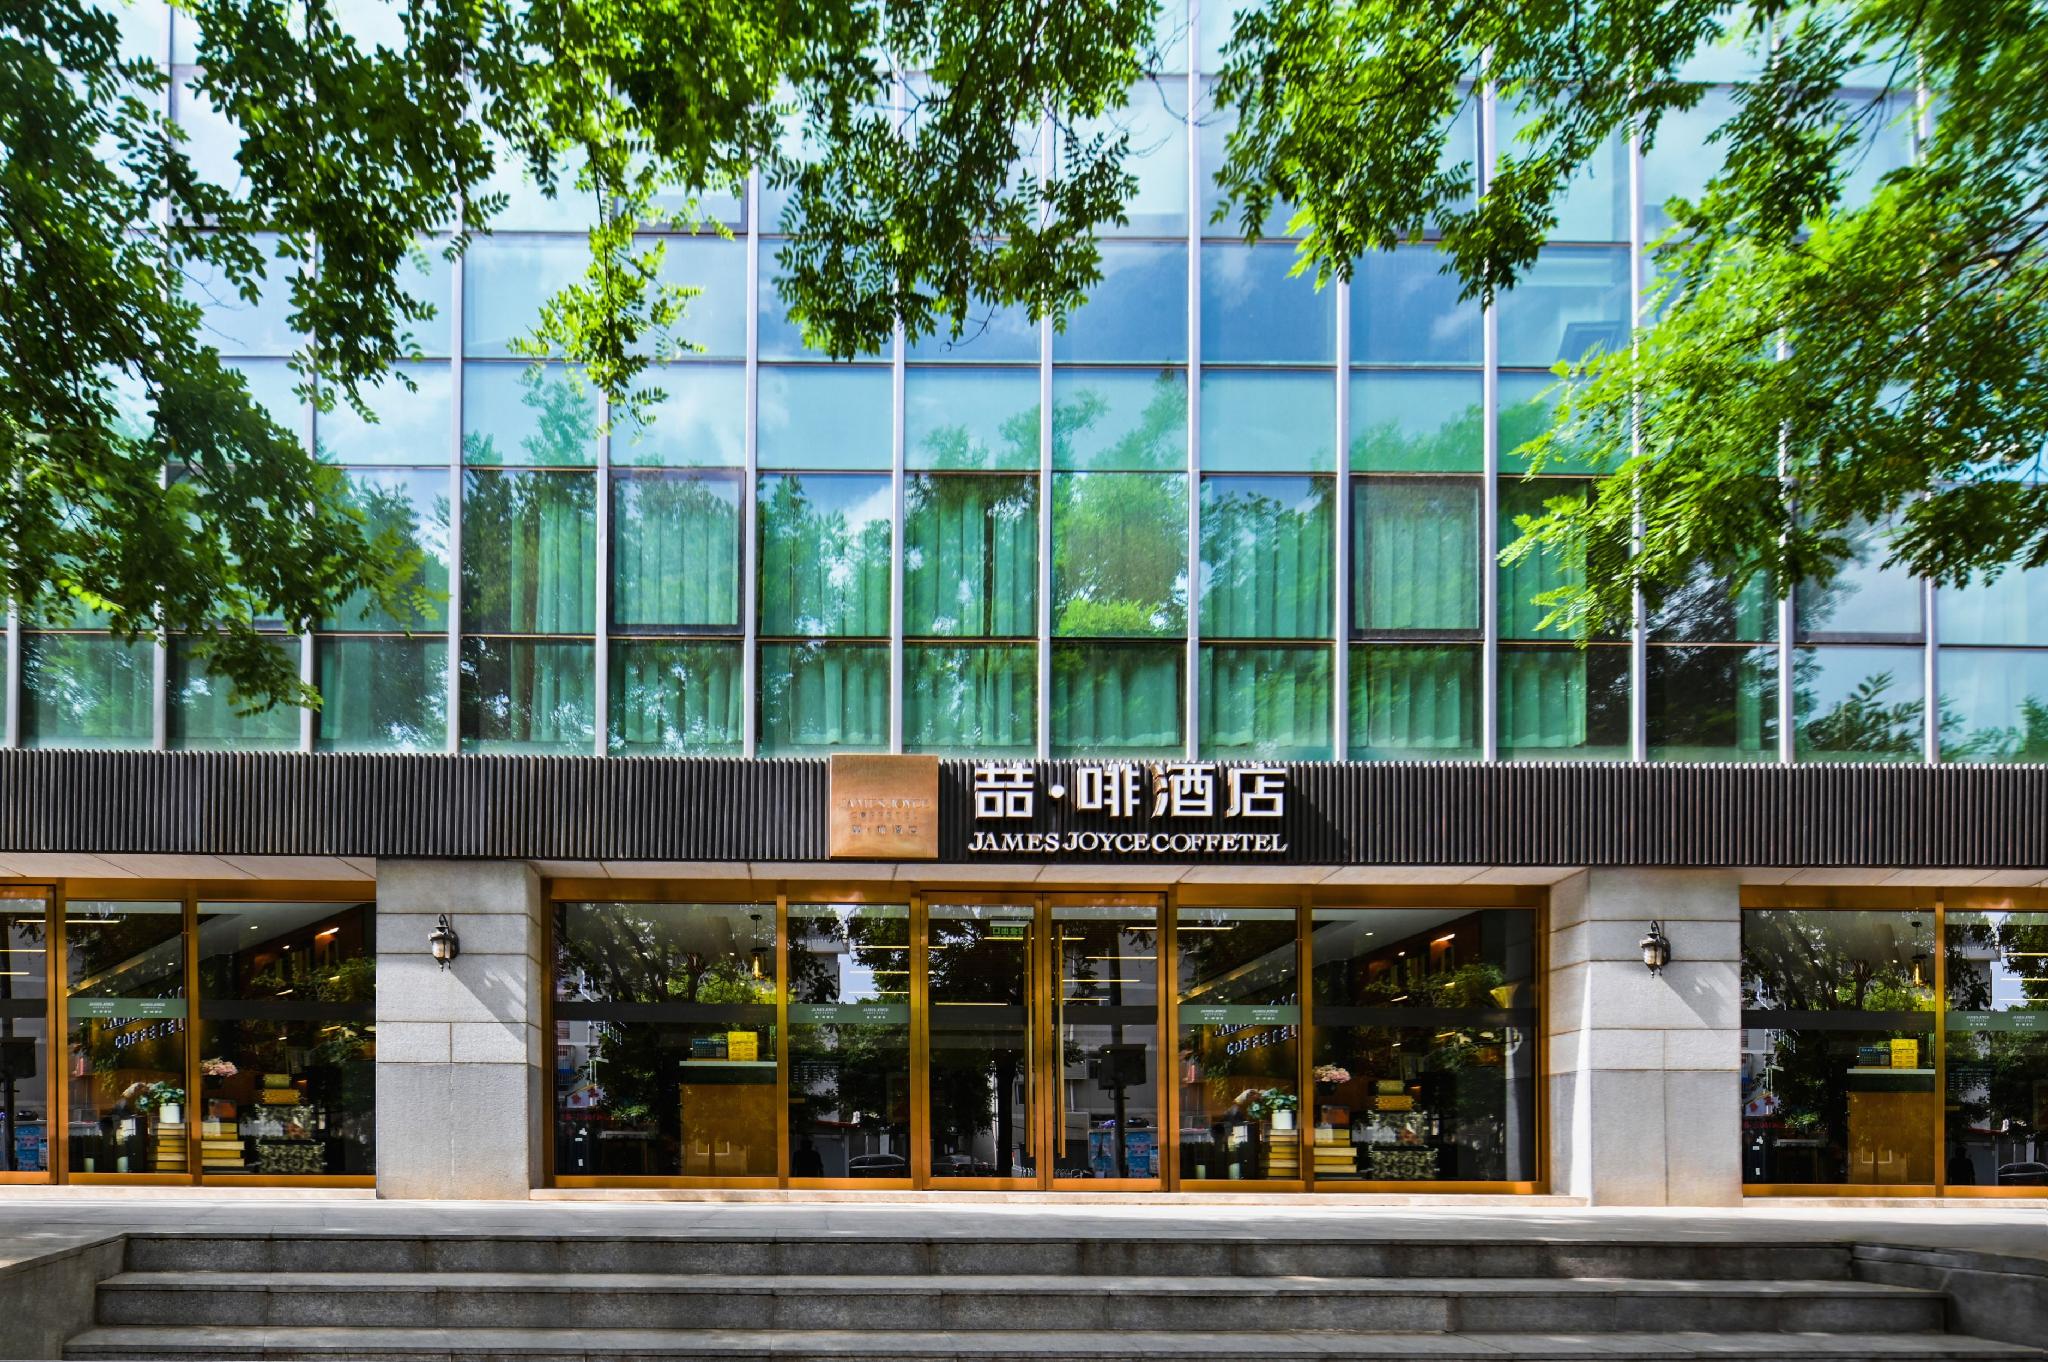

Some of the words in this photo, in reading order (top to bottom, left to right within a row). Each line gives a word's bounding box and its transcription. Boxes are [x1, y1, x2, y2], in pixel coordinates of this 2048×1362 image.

[968, 831, 1061, 853] JAMES
[1062, 831, 1150, 854] JOYCE
[1151, 832, 1288, 854] COFFETEL
